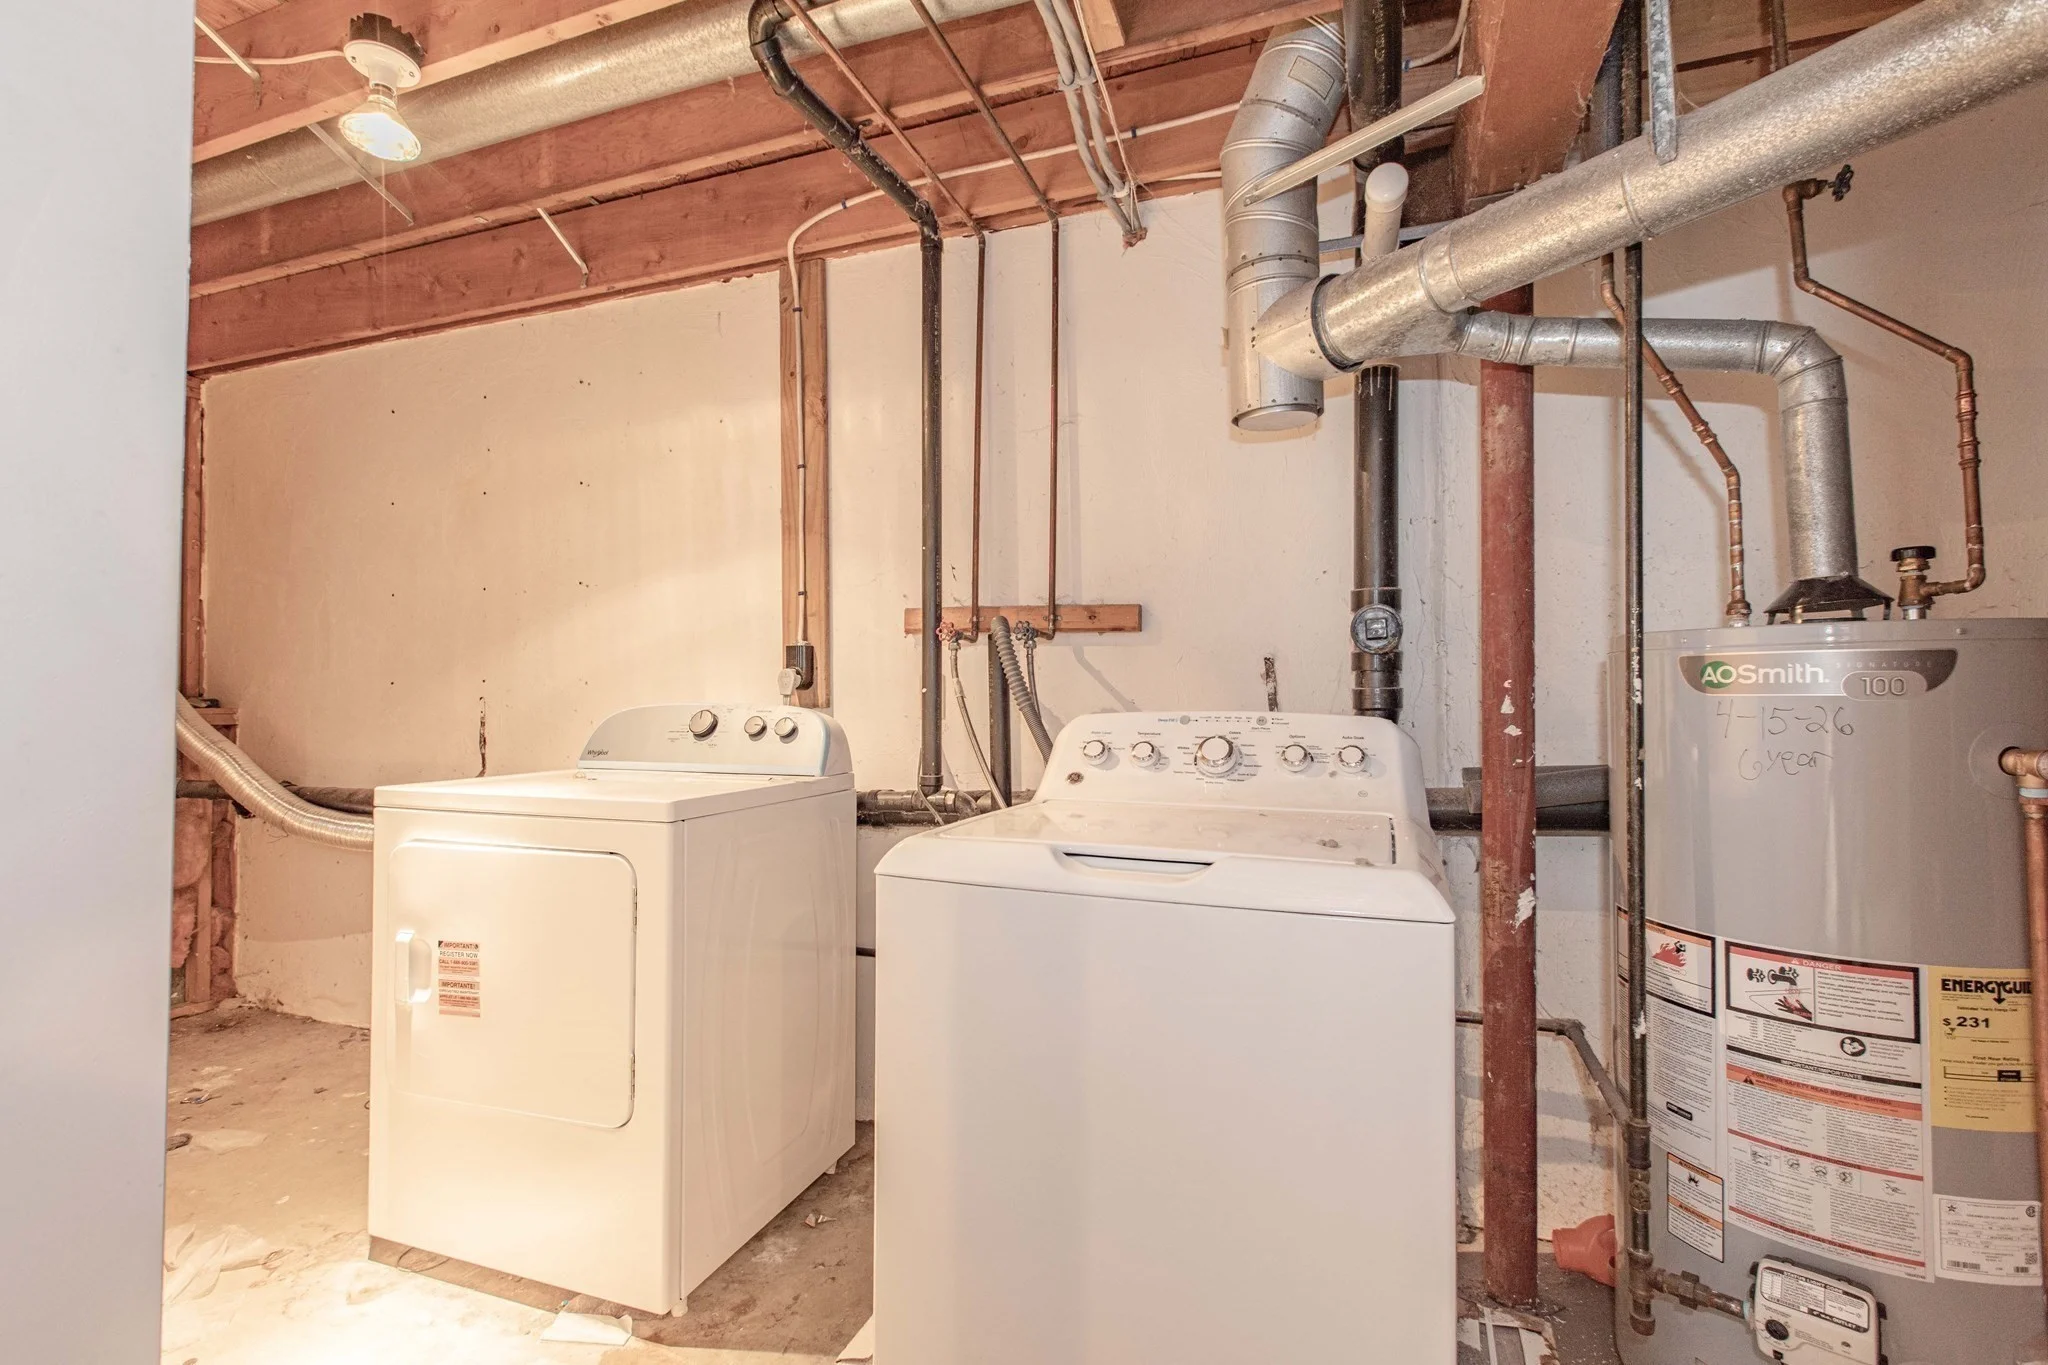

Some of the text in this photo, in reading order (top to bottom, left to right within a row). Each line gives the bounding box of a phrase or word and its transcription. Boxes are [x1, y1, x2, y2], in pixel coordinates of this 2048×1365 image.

[1862, 676, 1907, 696] 100
[1766, 750, 1834, 776] year
[1802, 959, 1842, 972] DANGER
[1956, 1016, 1990, 1029] 231
[1784, 1078, 1809, 1089] SAFETY
